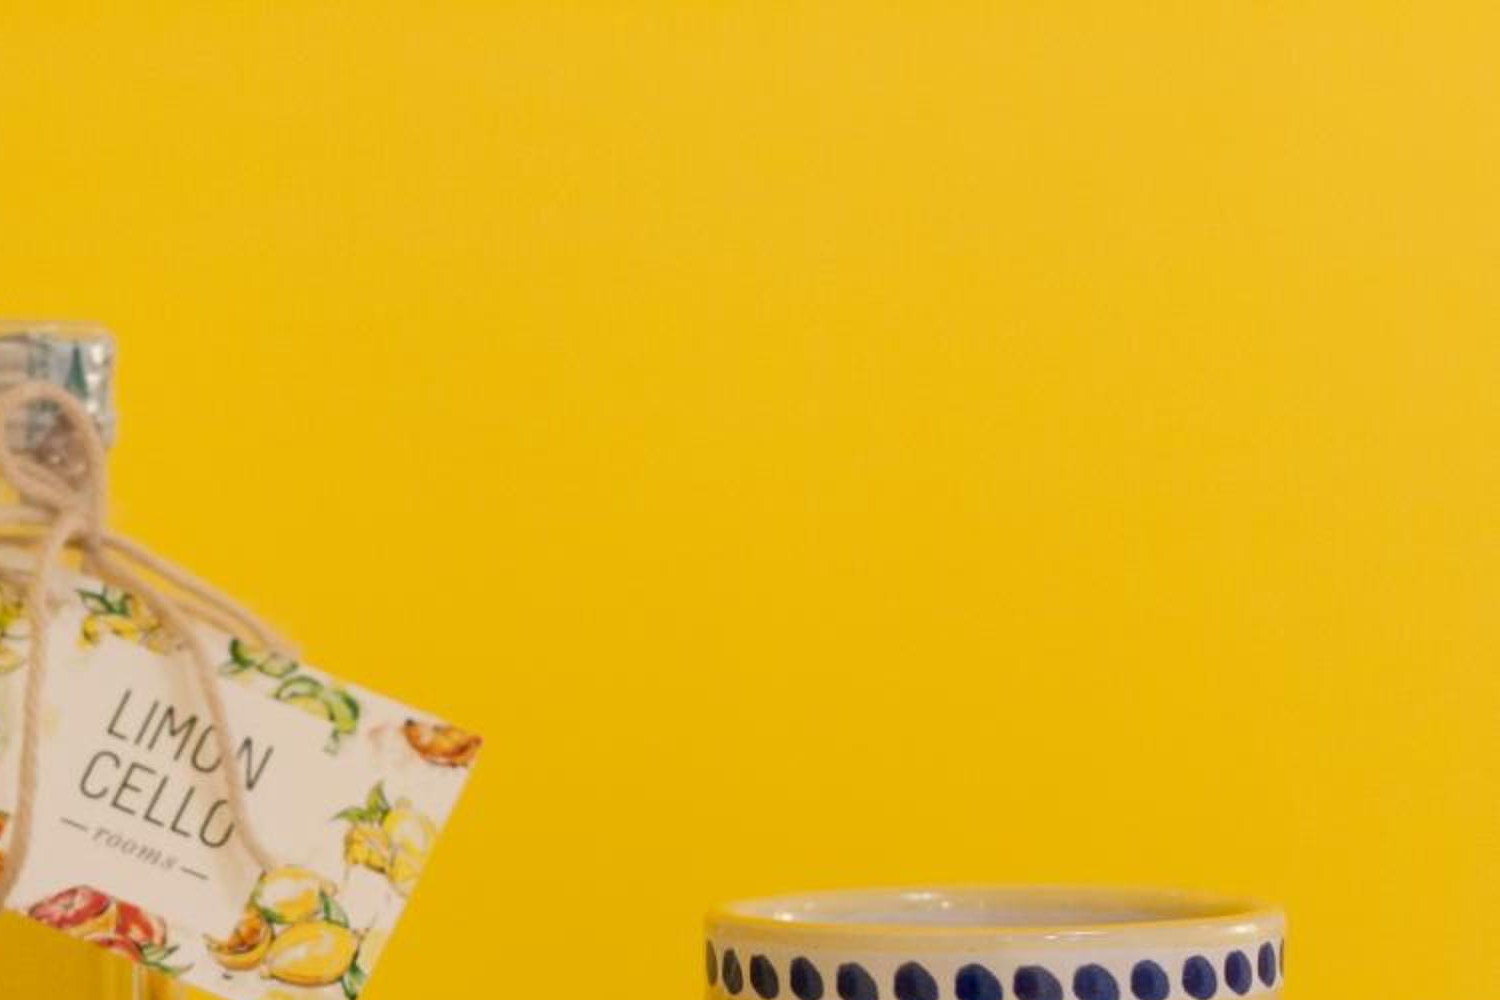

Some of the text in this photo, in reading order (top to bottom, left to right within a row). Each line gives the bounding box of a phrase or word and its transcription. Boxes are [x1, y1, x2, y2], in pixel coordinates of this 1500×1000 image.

[106, 689, 274, 790] LIMON
[79, 750, 239, 848] CELLO
[92, 826, 179, 870] rooms
